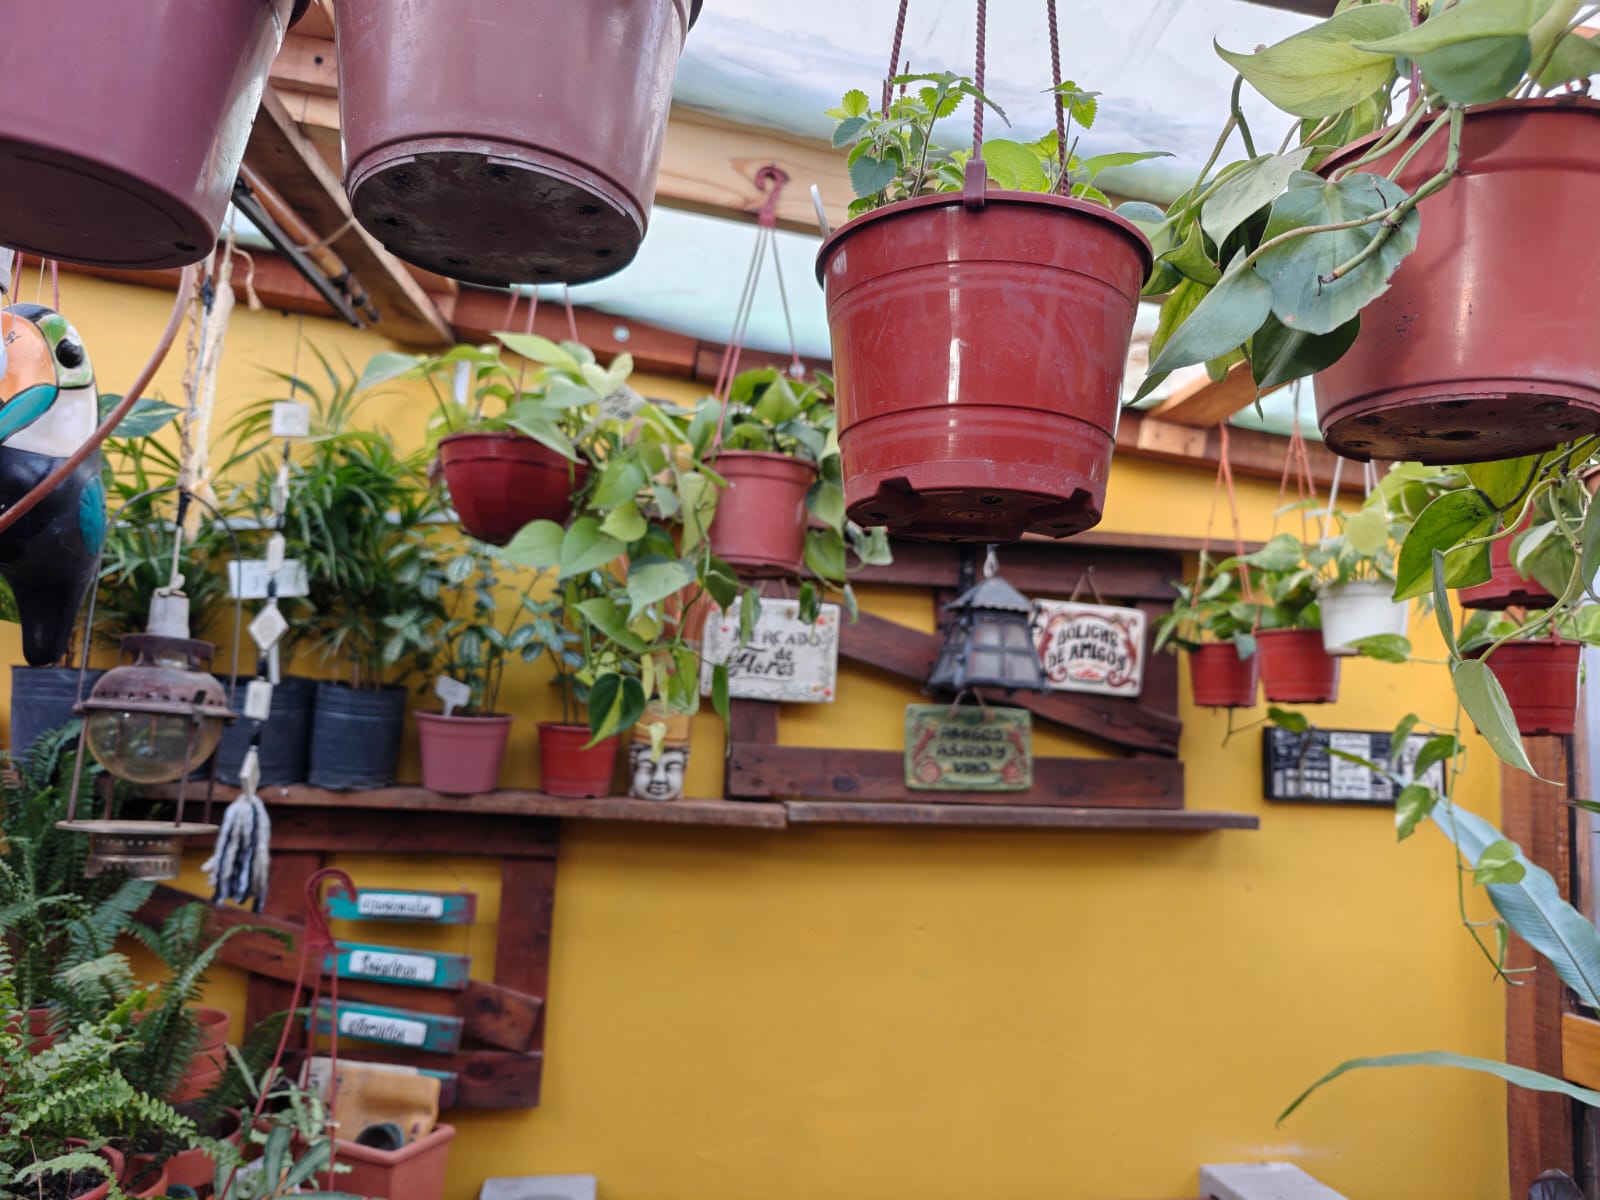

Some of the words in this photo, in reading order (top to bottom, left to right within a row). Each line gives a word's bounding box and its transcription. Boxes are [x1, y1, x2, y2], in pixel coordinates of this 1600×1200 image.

[774, 647, 793, 661] de
[1048, 648, 1065, 668] DE
[1070, 642, 1126, 672] AMIGOS
